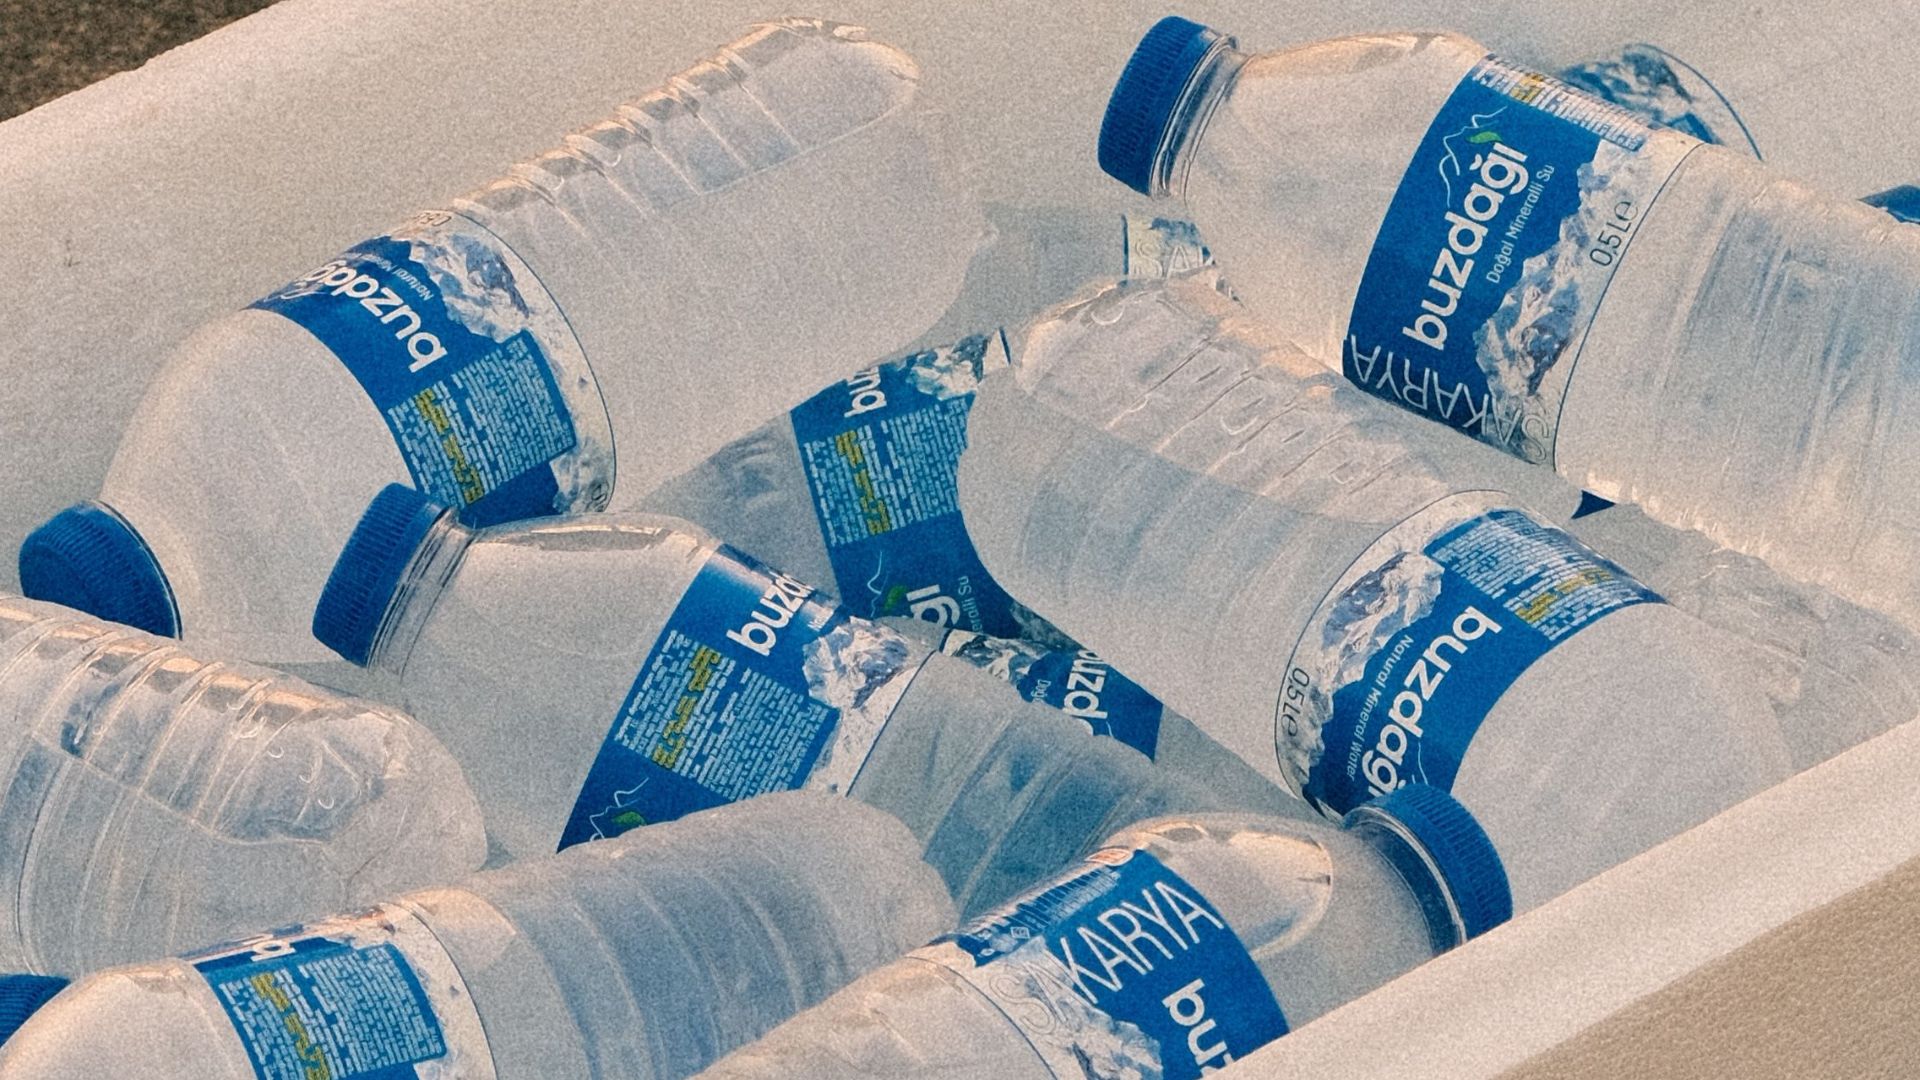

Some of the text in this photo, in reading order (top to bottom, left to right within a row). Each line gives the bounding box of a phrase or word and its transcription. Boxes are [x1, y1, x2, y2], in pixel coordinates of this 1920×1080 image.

[1402, 142, 1529, 350] buzdağı
[1486, 164, 1555, 284] Doğal Mineralli Su
[1350, 334, 1550, 465] SAKARYA
[1346, 634, 1414, 782] Natural Mineral Water
[989, 881, 1225, 1035] SAKARYA
